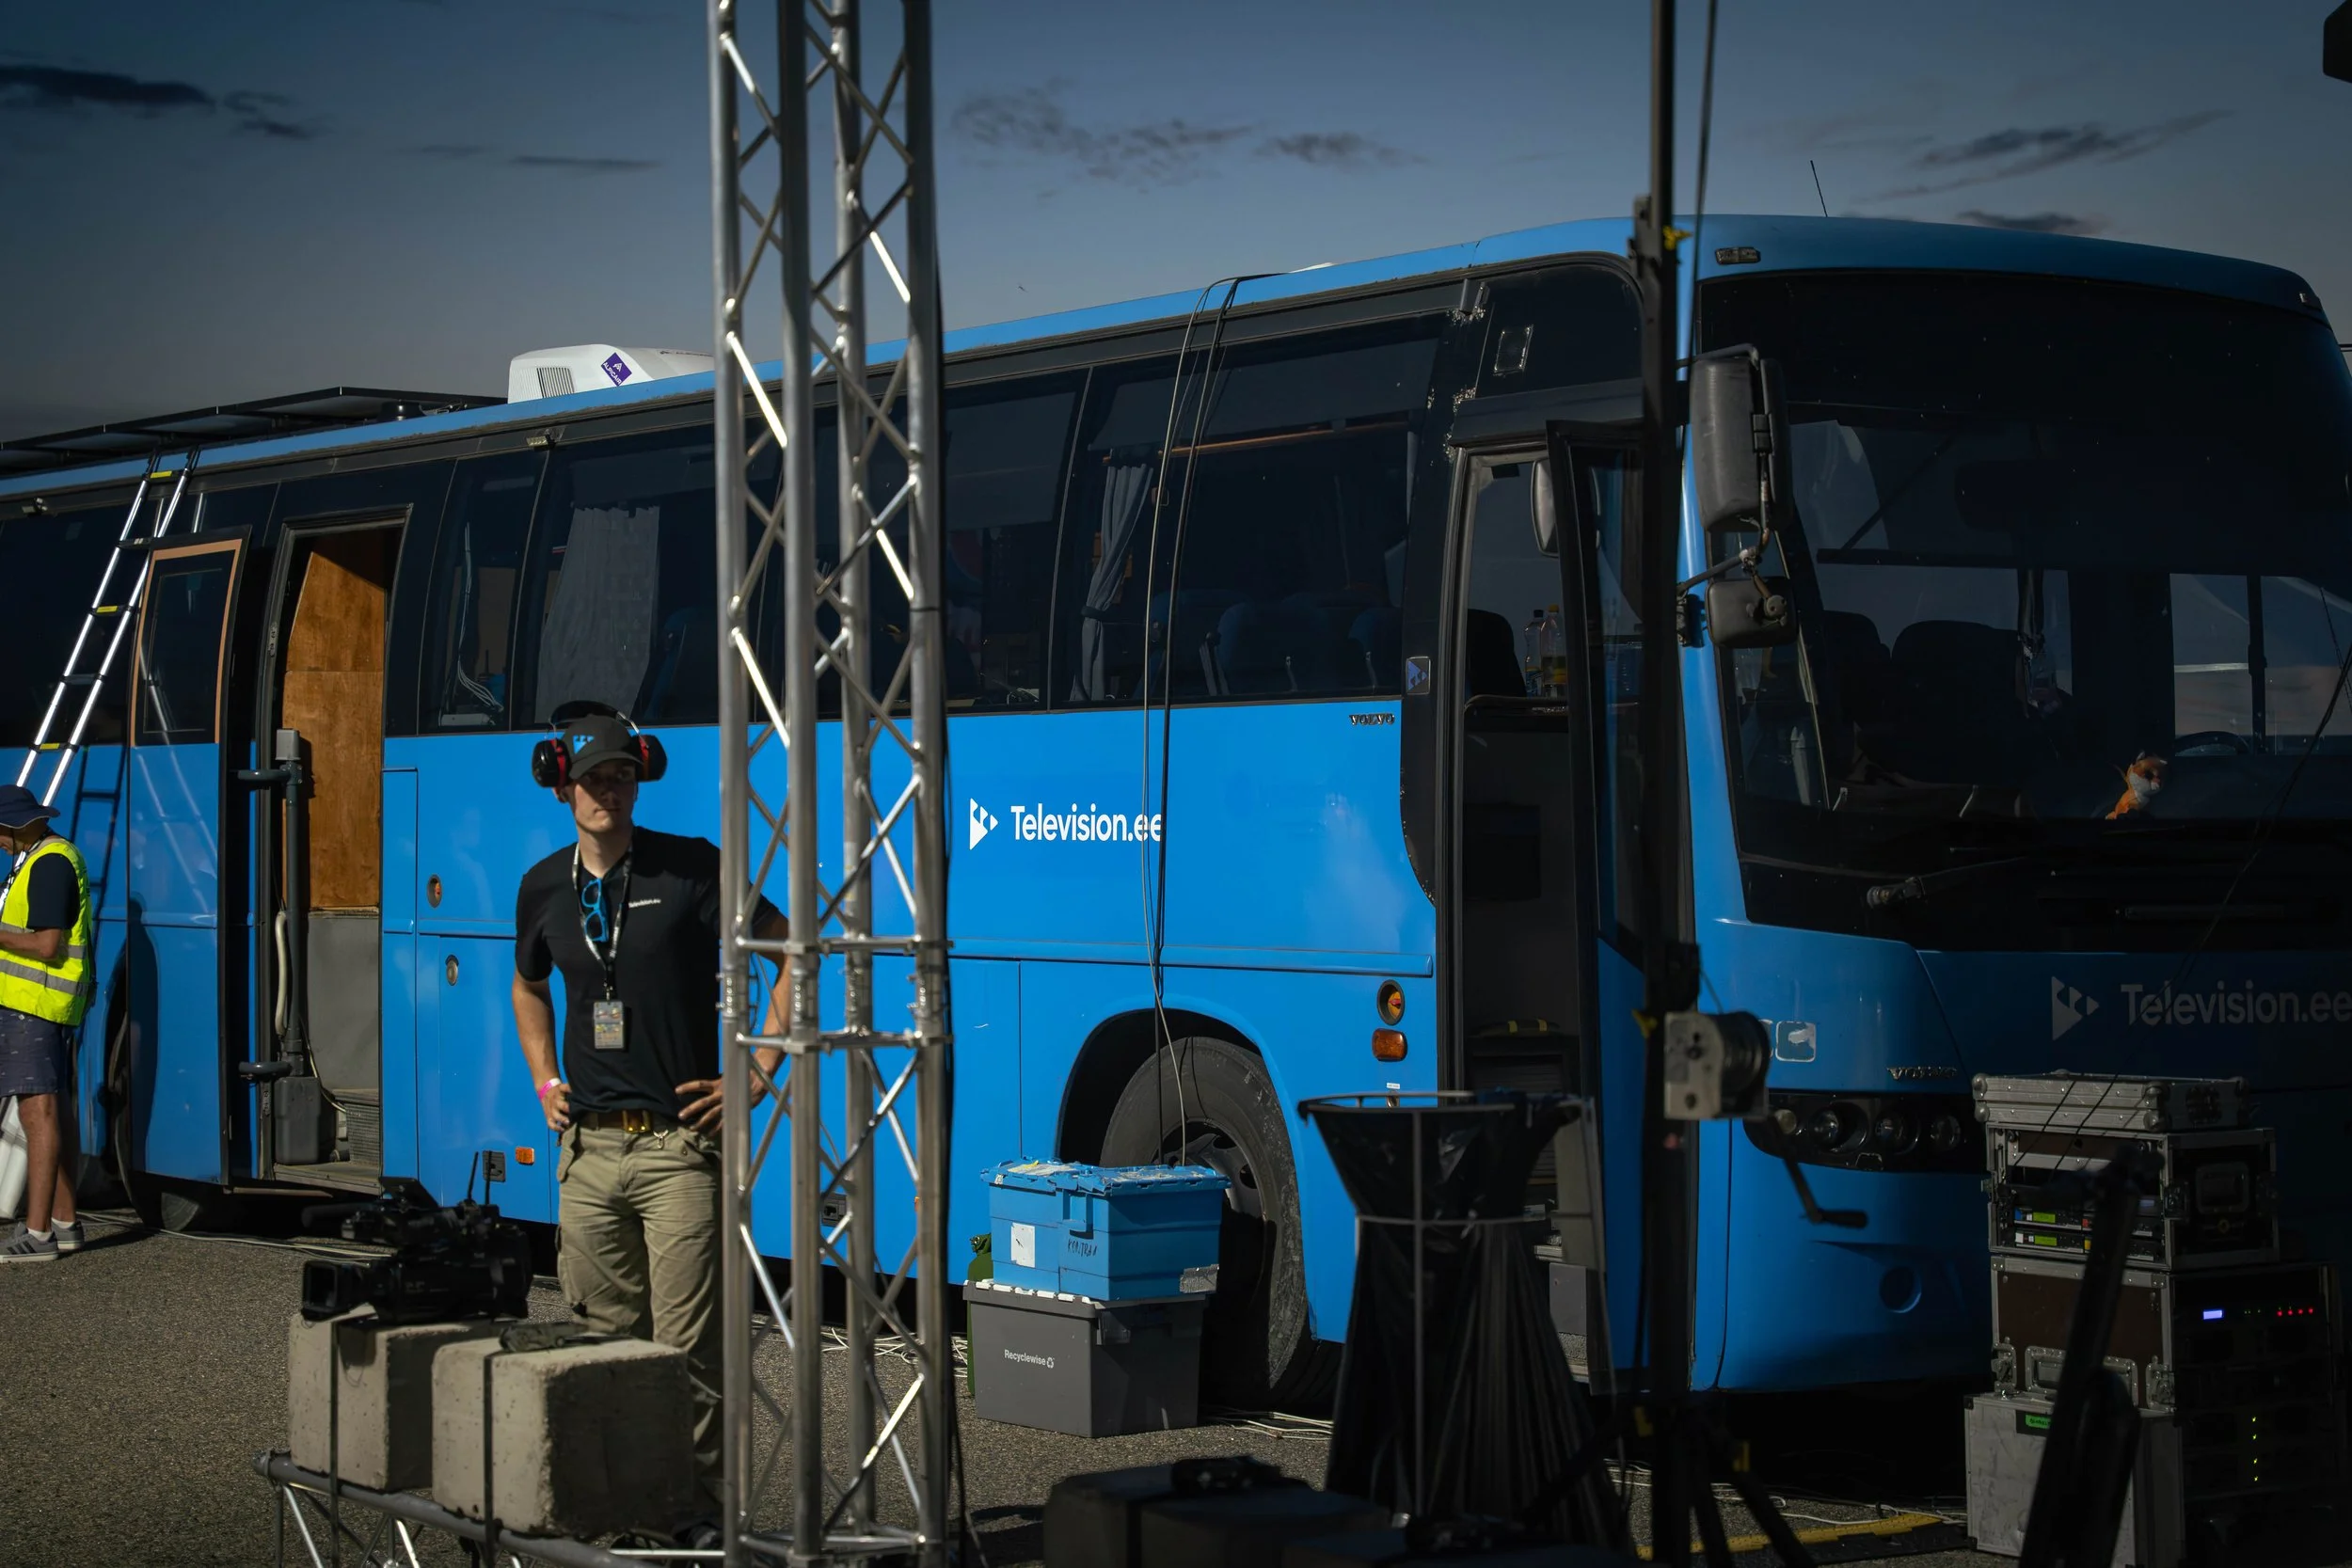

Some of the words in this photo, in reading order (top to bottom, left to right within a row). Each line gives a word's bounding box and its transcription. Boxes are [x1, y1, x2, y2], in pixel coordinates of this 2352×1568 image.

[603, 361, 622, 385] ALPICAIR
[1348, 713, 1395, 725] VOLVO
[1010, 802, 1163, 842] Television.ee
[2120, 979, 2352, 1026] Television.ee
[1004, 1349, 1046, 1366] Recyclewise
